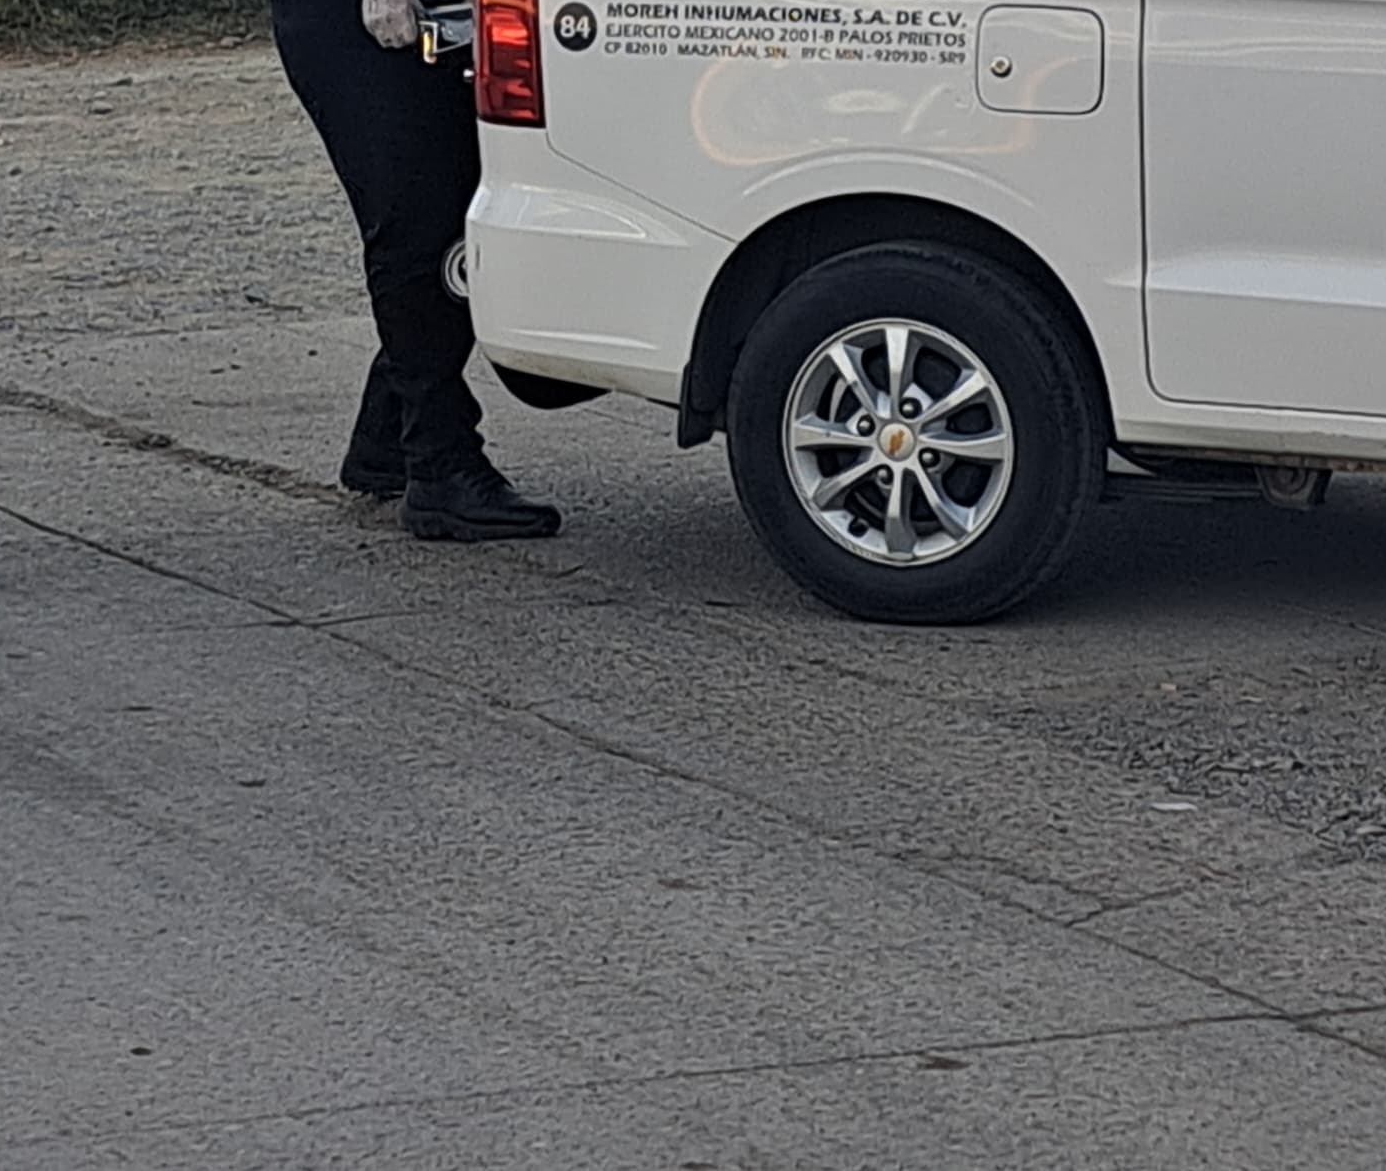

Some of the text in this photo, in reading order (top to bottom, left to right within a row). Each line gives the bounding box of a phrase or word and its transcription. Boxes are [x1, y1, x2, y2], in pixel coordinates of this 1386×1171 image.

[560, 14, 592, 40] 84
[607, 3, 968, 29] MOREH INHUMACIONES, S.A. DE C.V.
[605, 23, 681, 40] EJERCITO
[684, 25, 776, 43] MEXICANO
[838, 30, 893, 46] PALOS
[897, 31, 966, 48] PRIETOS
